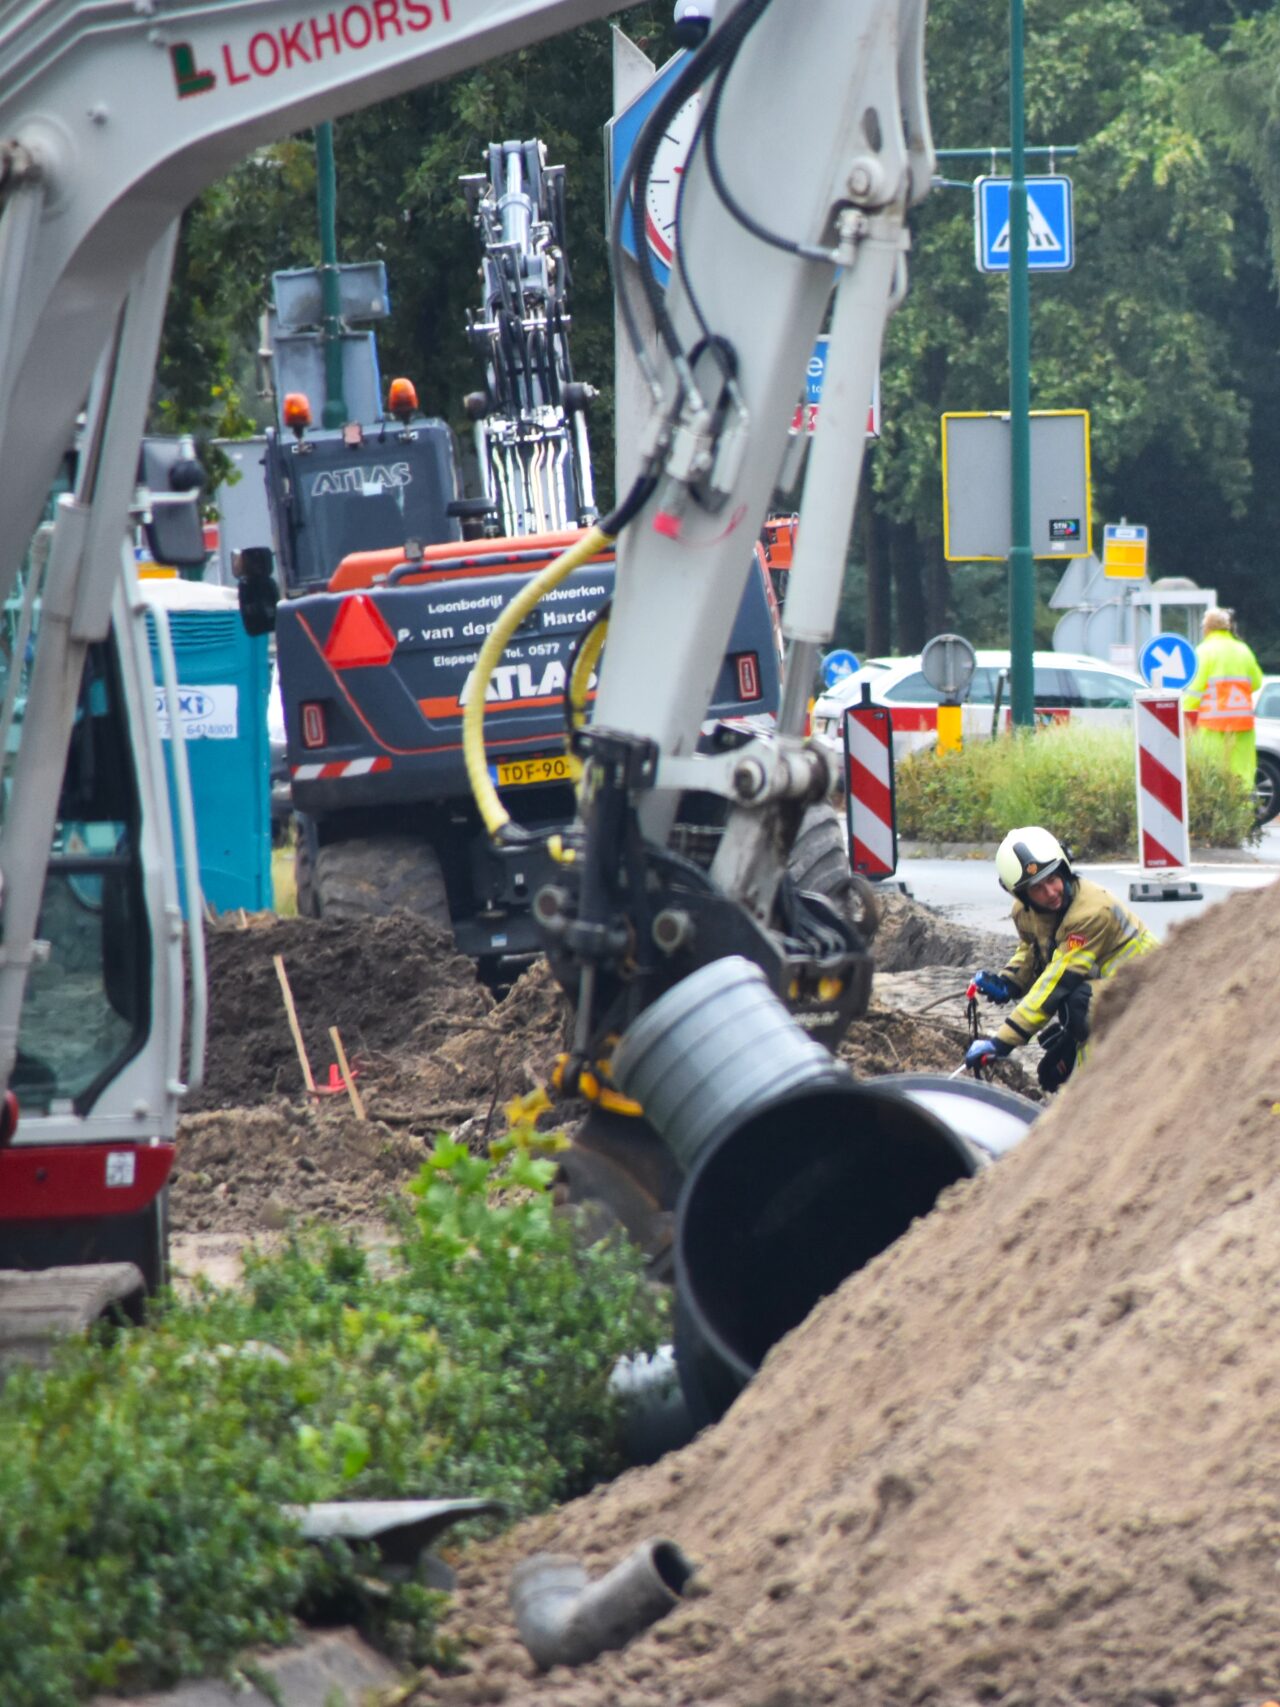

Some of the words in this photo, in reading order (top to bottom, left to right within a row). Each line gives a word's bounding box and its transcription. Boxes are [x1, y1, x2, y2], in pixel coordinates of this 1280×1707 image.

[311, 462, 412, 497] ATLAS
[428, 594, 504, 615] Loonbedrijf
[421, 627, 454, 642] van
[543, 608, 598, 628] Harde
[504, 648, 525, 659] Tel.
[528, 642, 561, 655] 0577
